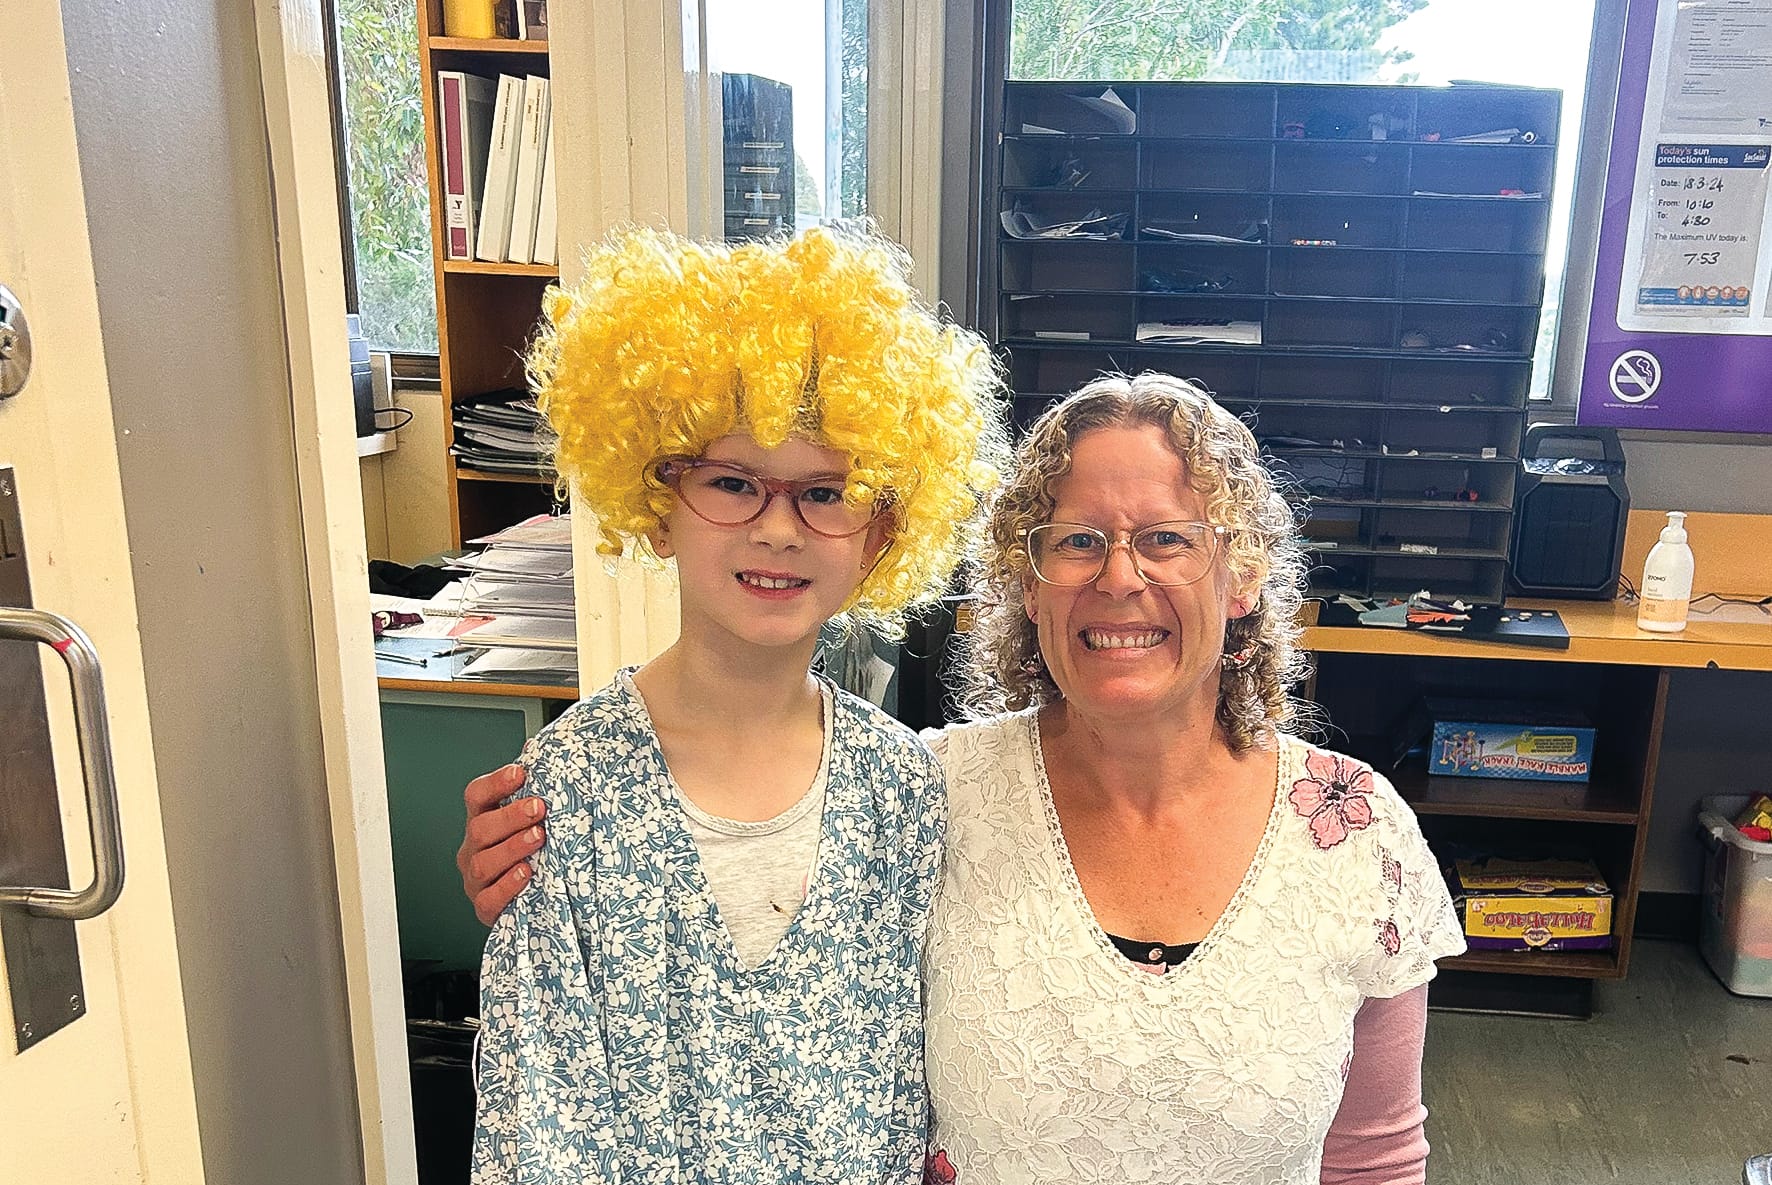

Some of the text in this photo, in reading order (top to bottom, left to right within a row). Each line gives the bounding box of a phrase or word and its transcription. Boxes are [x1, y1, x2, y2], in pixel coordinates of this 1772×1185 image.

[1660, 146, 1691, 156] Today's
[1657, 155, 1729, 164] protection times
[1660, 179, 1680, 187] Date:
[1657, 199, 1680, 207] From:
[1657, 211, 1711, 227] To: 4:30
[1654, 233, 1667, 241] The
[1669, 233, 1704, 241] Maximum
[1705, 233, 1717, 241] UV
[1718, 233, 1738, 243] today
[1482, 754, 1588, 775] MARBLE RACE TRACK
